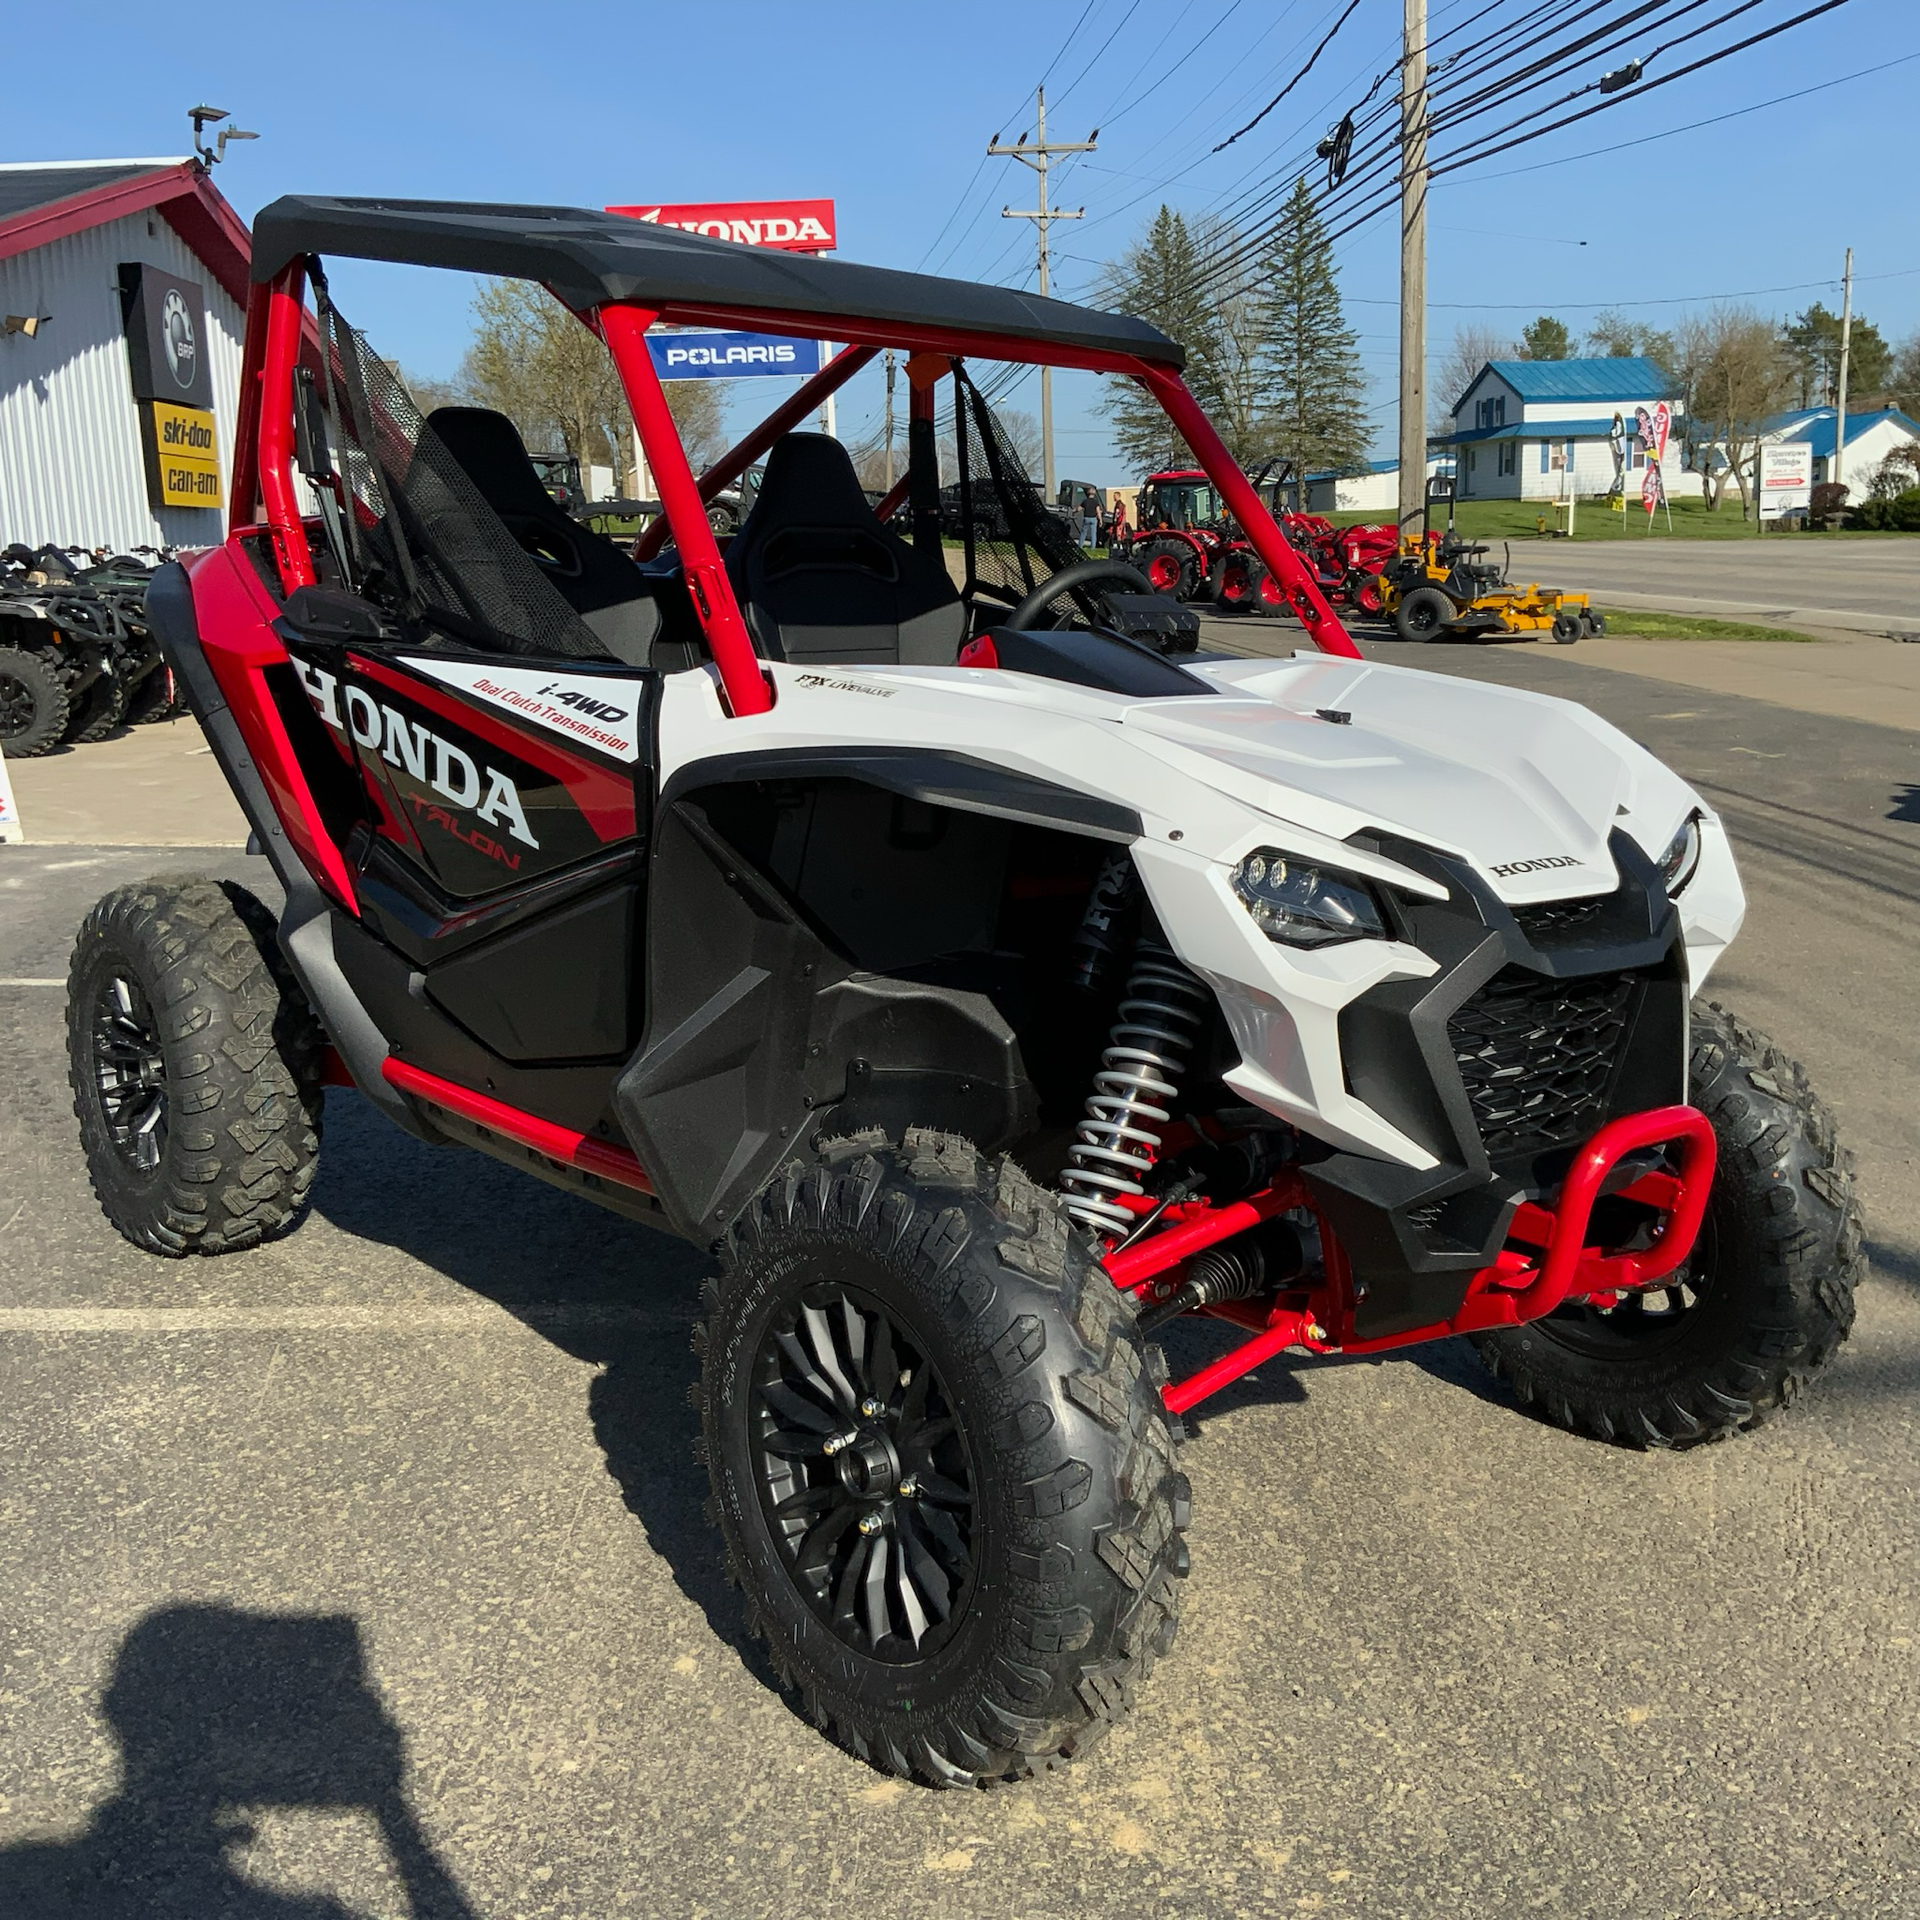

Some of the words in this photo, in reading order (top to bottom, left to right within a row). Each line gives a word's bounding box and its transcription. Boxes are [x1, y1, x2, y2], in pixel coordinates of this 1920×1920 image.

[669, 218, 832, 245] ONDA
[177, 341, 195, 360] BRP
[667, 345, 796, 367] POLARIS
[164, 416, 212, 450] ski-doo
[168, 468, 218, 496] can-am
[472, 678, 507, 697] Dual
[501, 690, 542, 714] Clutch
[540, 706, 629, 751] Transmission
[536, 682, 629, 723] i-4WD
[288, 652, 540, 850] HONDA
[408, 791, 521, 871] TALON
[1488, 855, 1586, 878] HONDA
